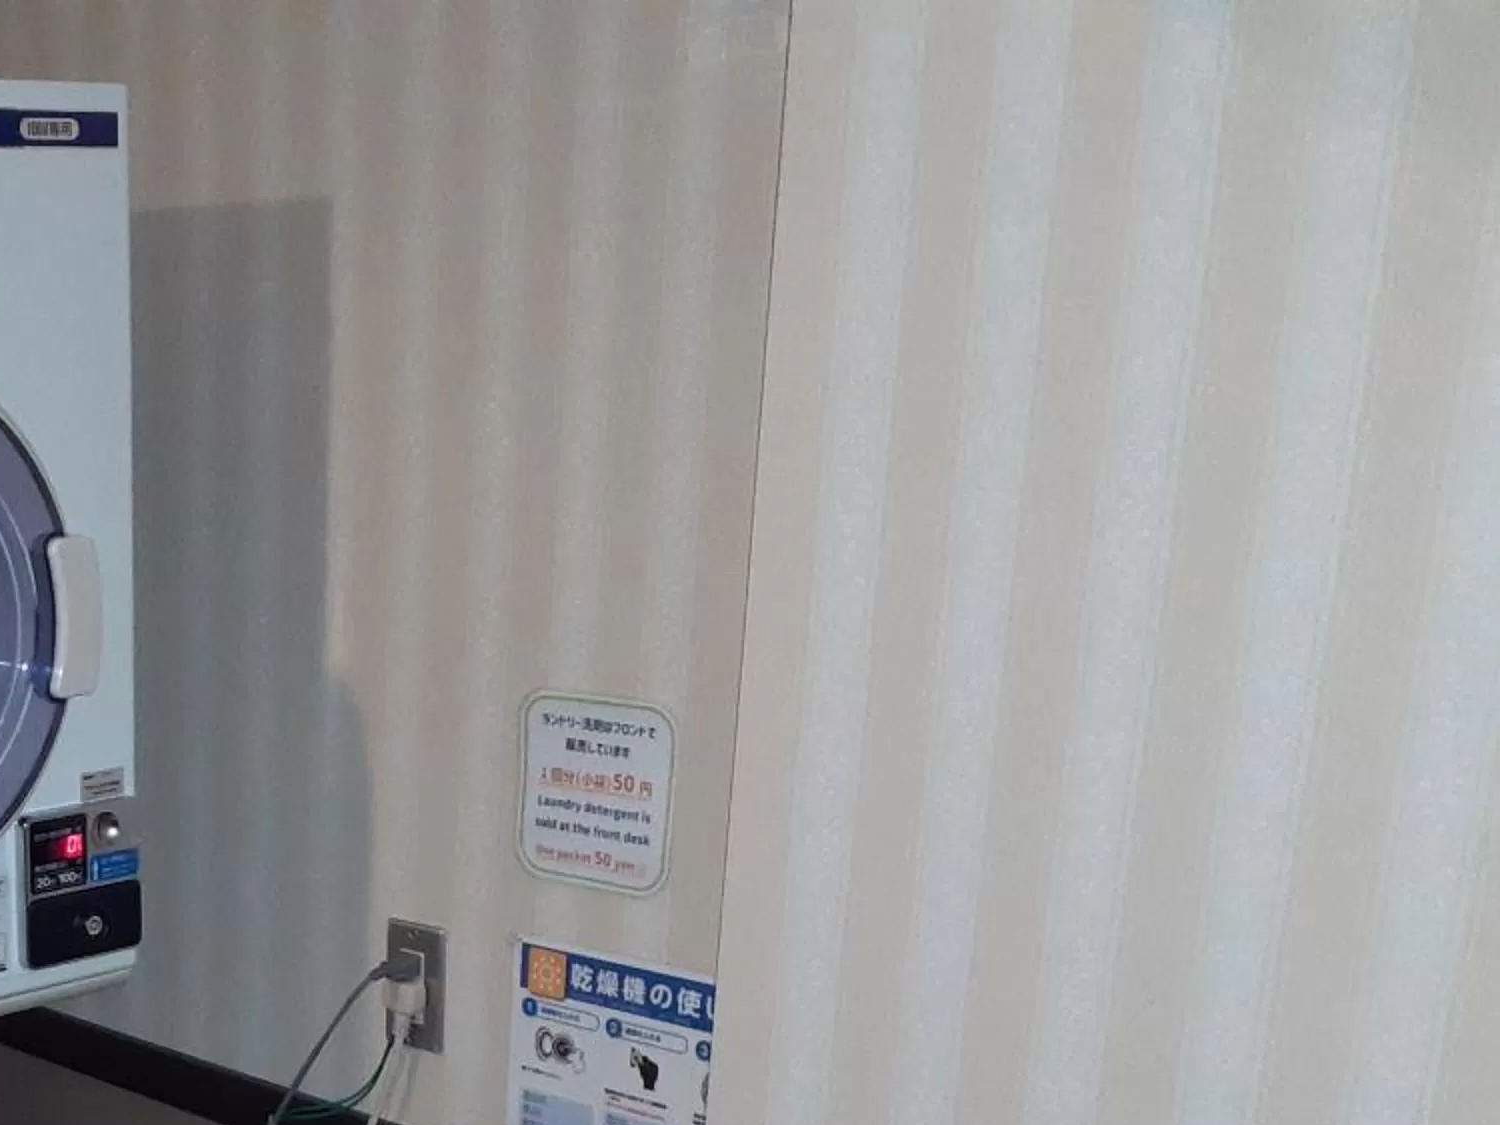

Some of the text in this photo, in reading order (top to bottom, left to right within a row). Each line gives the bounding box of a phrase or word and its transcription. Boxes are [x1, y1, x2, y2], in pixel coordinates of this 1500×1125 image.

[537, 795, 582, 814] Laundry
[584, 801, 640, 823] detergent
[572, 822, 591, 836] the
[593, 825, 621, 842] front
[623, 831, 650, 847] desk
[594, 850, 613, 868] 50
